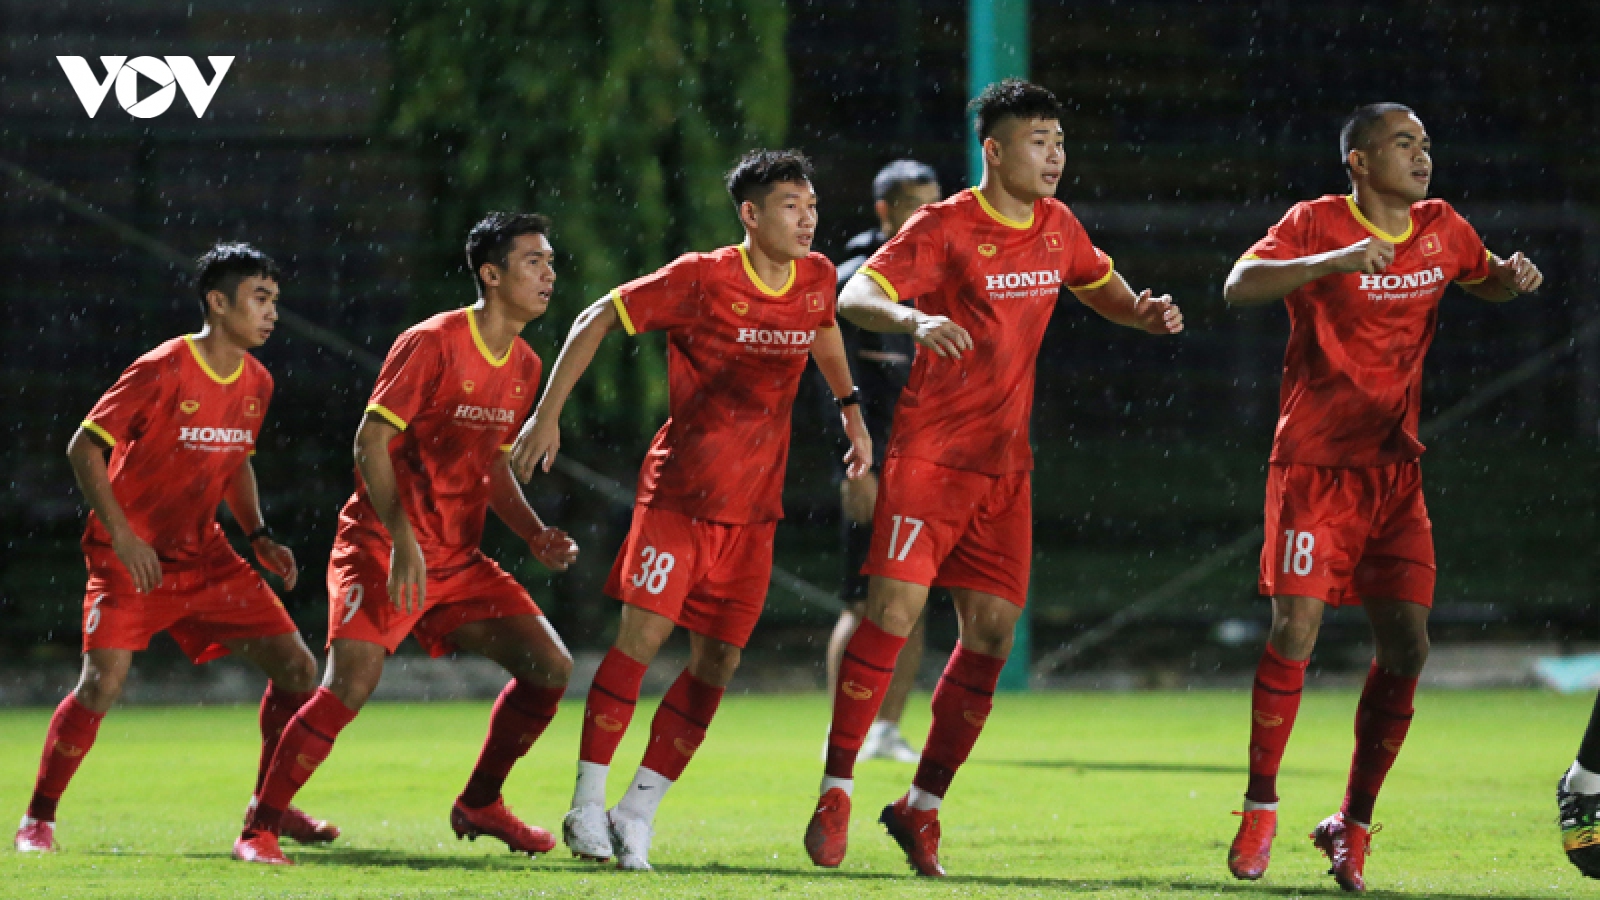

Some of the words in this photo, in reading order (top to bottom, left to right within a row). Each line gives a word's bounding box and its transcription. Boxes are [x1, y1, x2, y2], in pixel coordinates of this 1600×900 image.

[1358, 266, 1444, 290] HONDA
[454, 404, 514, 424] HONDA
[178, 427, 254, 445] HONDA
[887, 514, 924, 562] 17
[1283, 529, 1315, 577] 18
[632, 546, 675, 595] 38
[342, 584, 364, 624] 9
